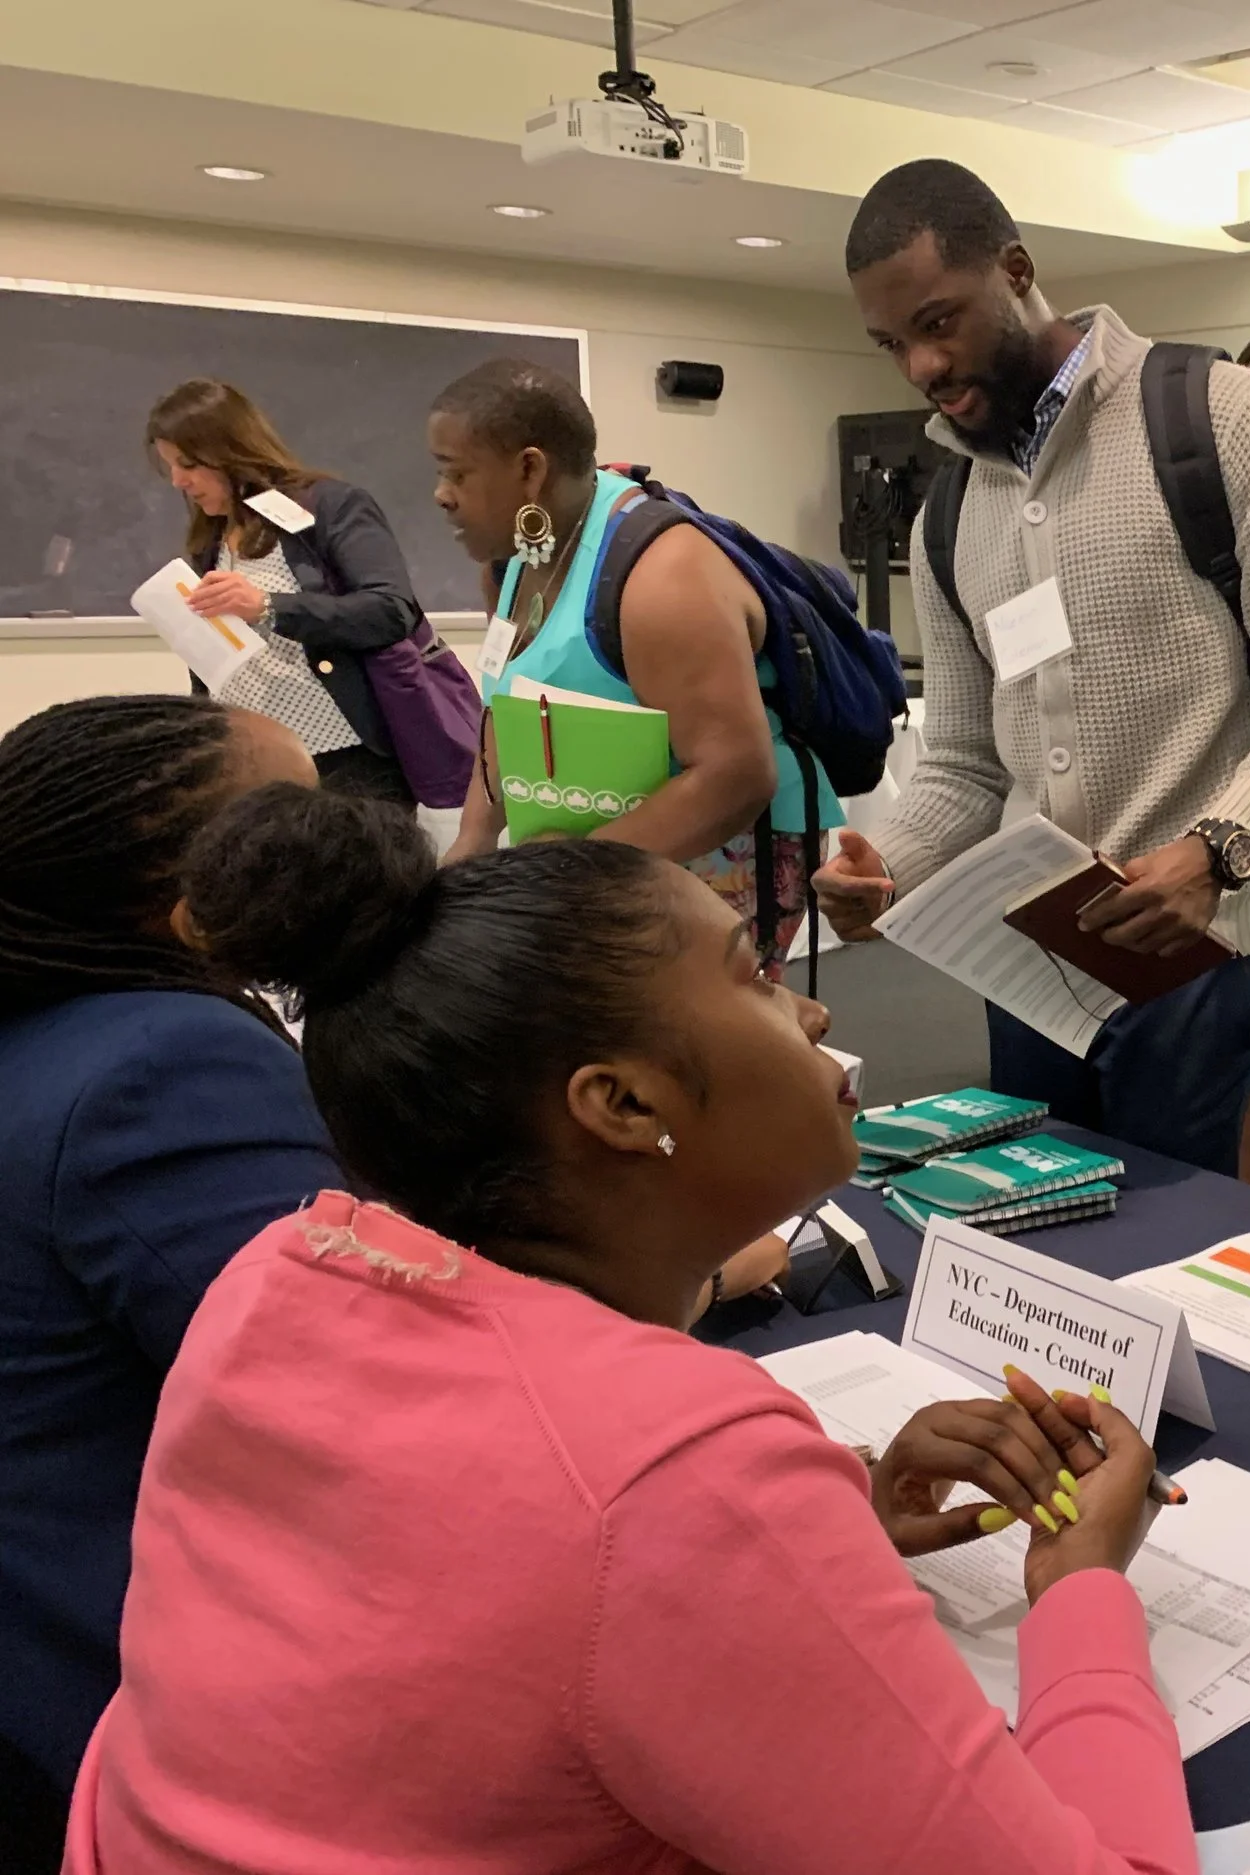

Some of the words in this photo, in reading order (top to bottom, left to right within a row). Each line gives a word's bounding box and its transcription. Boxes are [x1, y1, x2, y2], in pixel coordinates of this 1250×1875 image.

[947, 1263, 988, 1297] NYC
[1004, 1287, 1108, 1349] Department
[1112, 1336, 1134, 1358] of
[949, 1299, 1029, 1352] Education
[1046, 1342, 1114, 1389] Central
